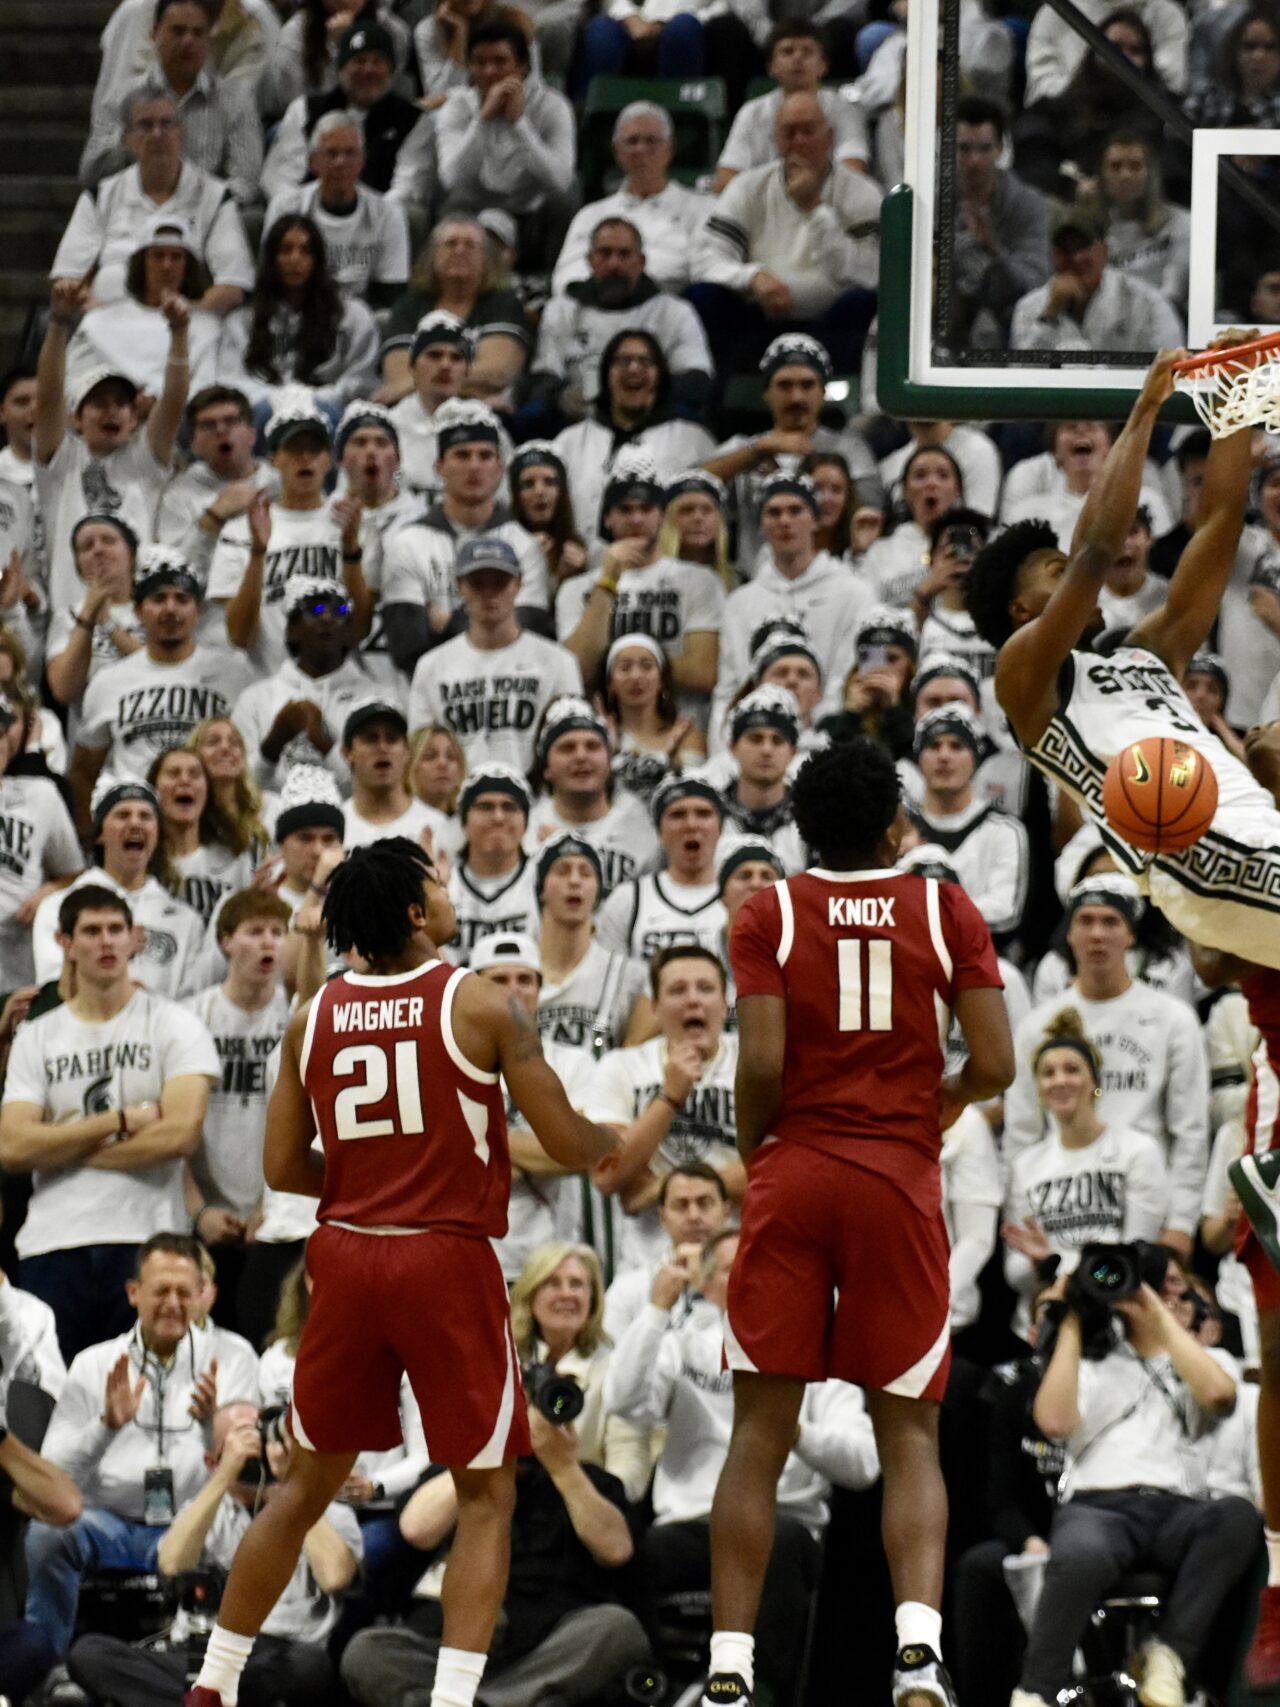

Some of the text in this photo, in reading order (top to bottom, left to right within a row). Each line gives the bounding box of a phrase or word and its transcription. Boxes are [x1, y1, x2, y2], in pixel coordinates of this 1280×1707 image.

[444, 699, 535, 734] SHIELD
[828, 896, 896, 927] KNOX
[837, 938, 893, 1032] 11
[332, 996, 425, 1034] WAGNER
[332, 1040, 425, 1141] 21
